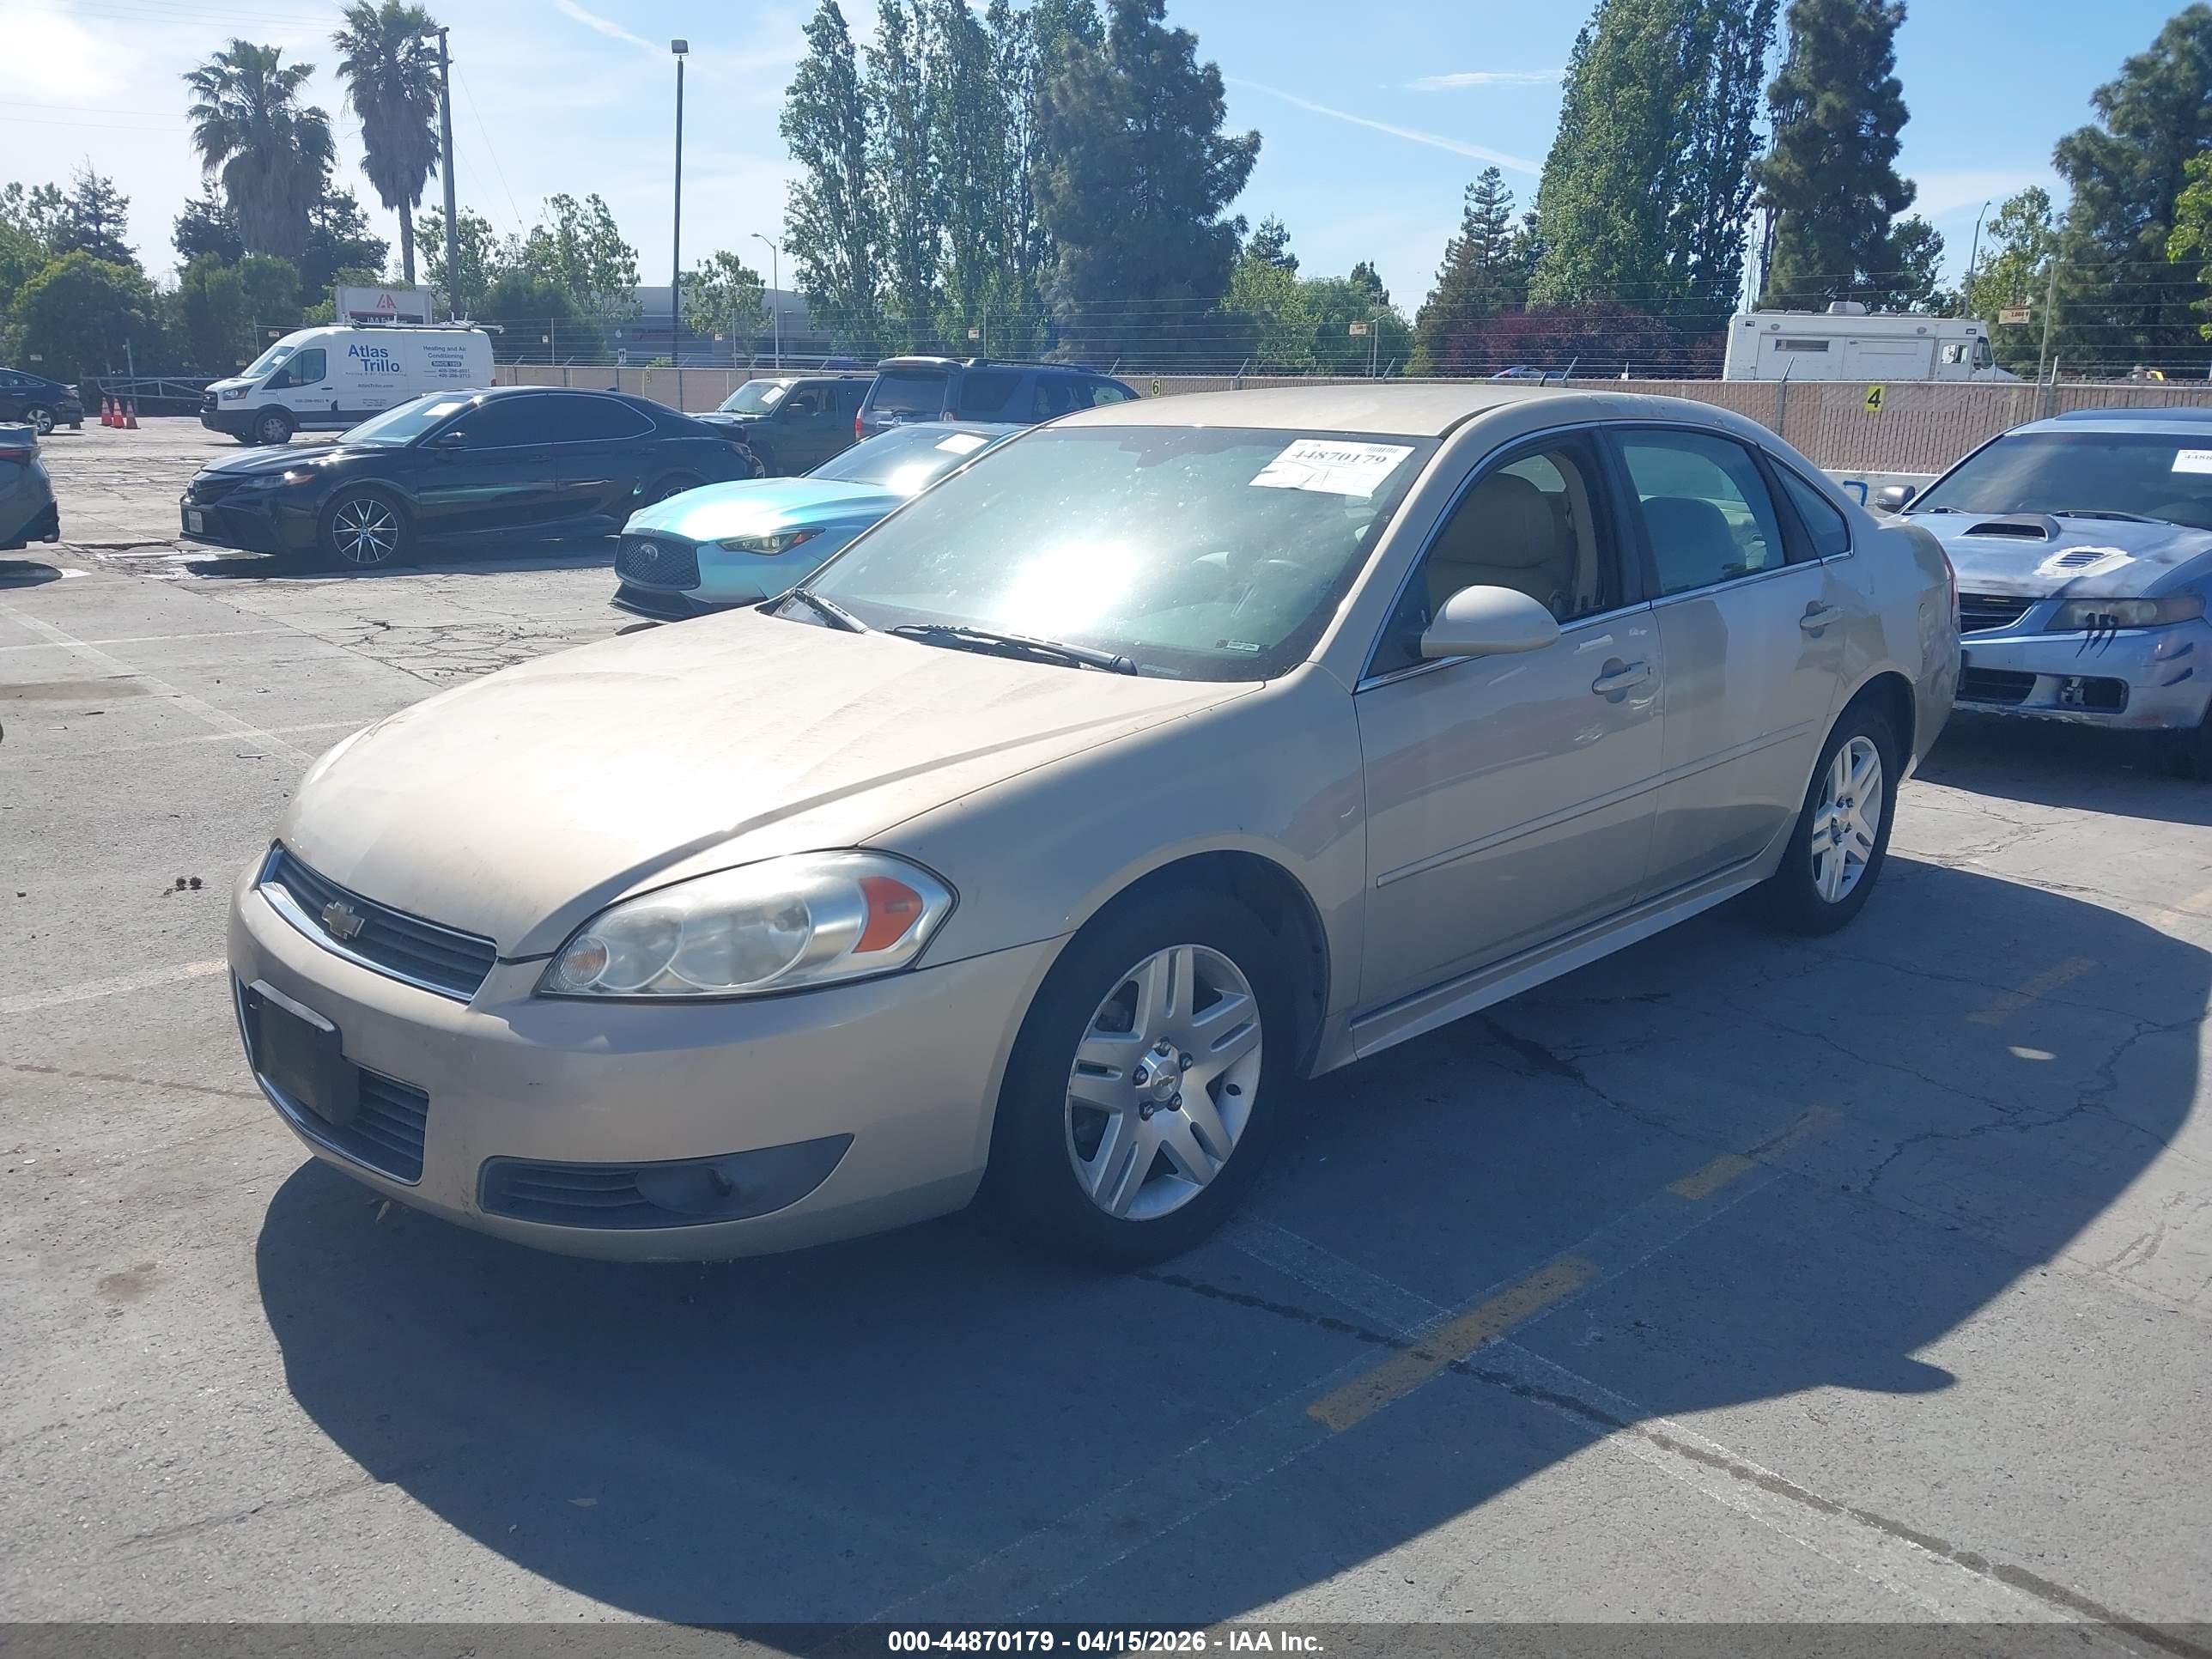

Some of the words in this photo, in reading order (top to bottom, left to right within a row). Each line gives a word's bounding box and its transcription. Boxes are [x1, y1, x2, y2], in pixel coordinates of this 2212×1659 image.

[348, 344, 389, 357] Atlas
[361, 359, 400, 372] Trillo
[1152, 380, 1159, 395] 6
[1868, 388, 1881, 408] 4
[1291, 450, 1388, 465] 44870179
